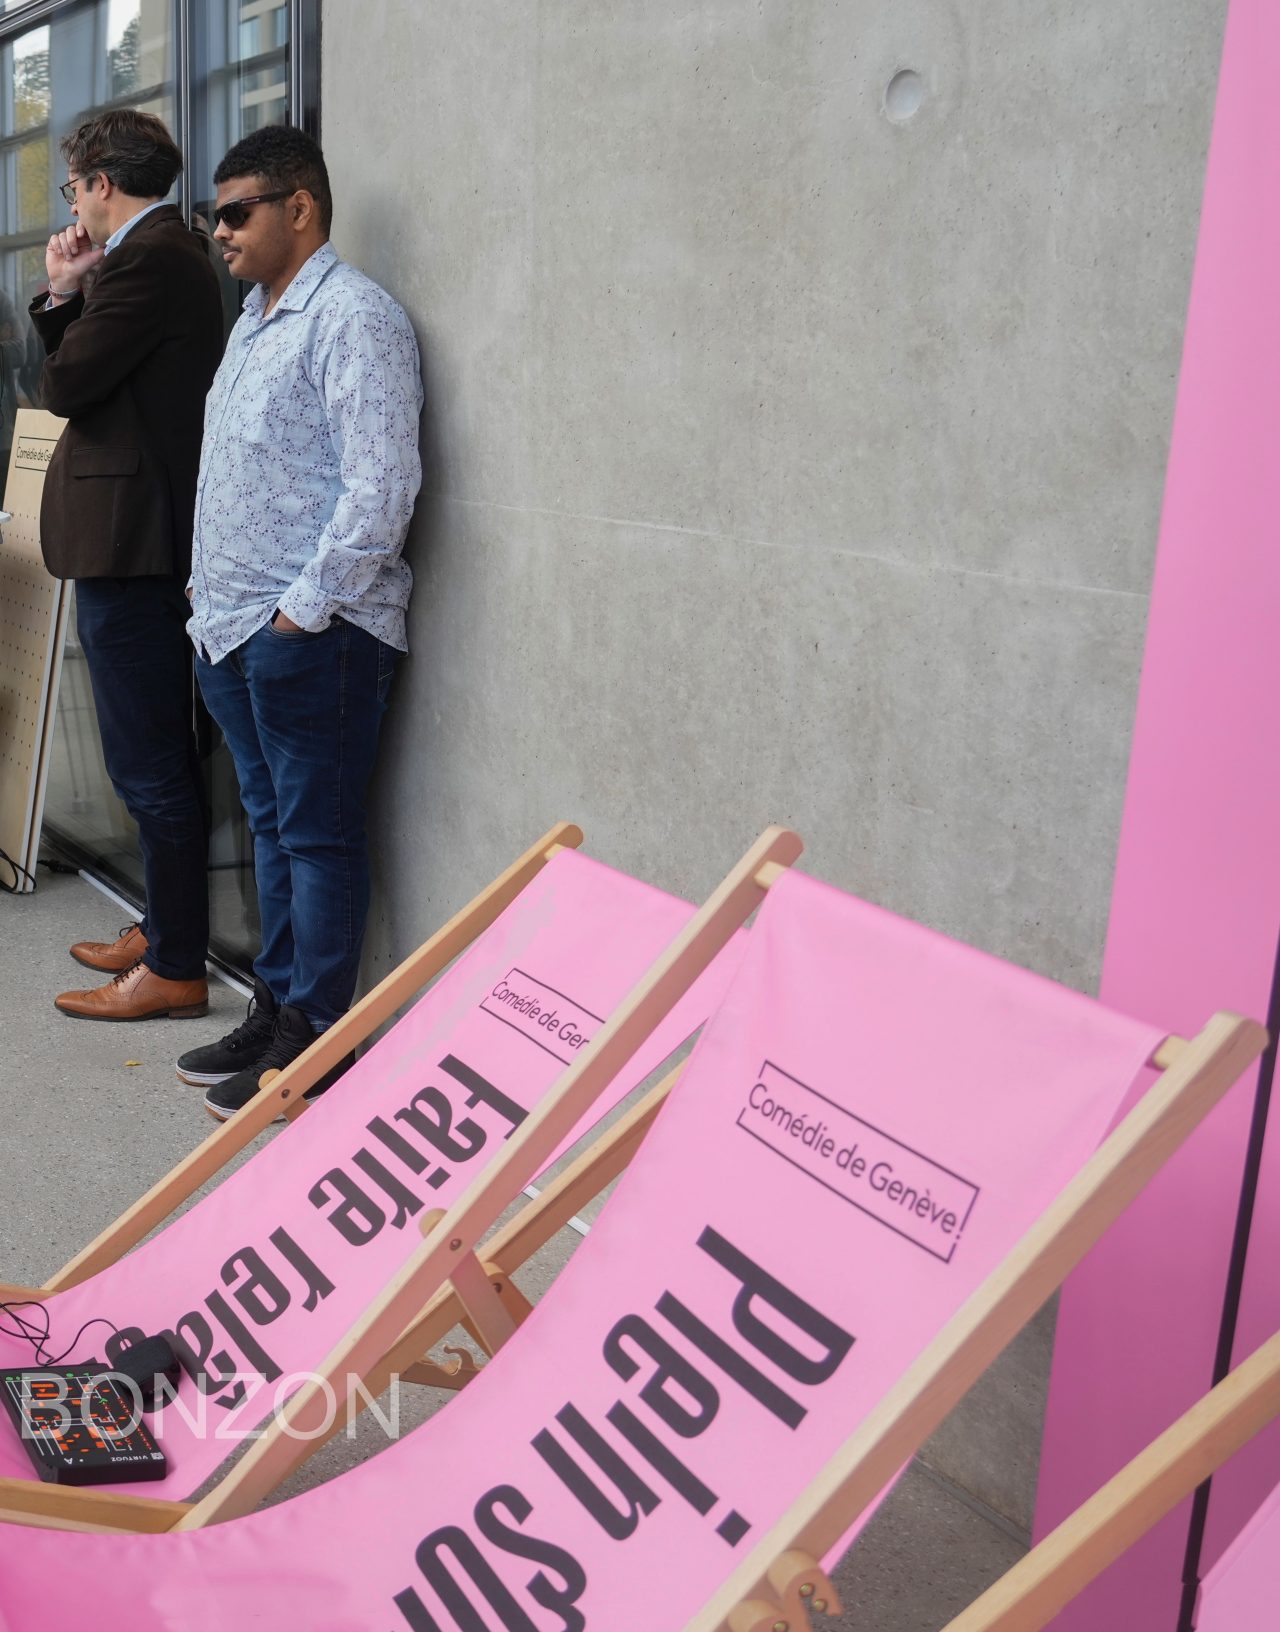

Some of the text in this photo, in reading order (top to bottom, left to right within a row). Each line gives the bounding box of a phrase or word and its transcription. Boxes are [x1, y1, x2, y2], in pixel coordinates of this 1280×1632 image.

[492, 981, 541, 1019] Comédie
[537, 1010, 560, 1032] de
[748, 1082, 836, 1159] Comédie
[835, 1144, 867, 1178] de
